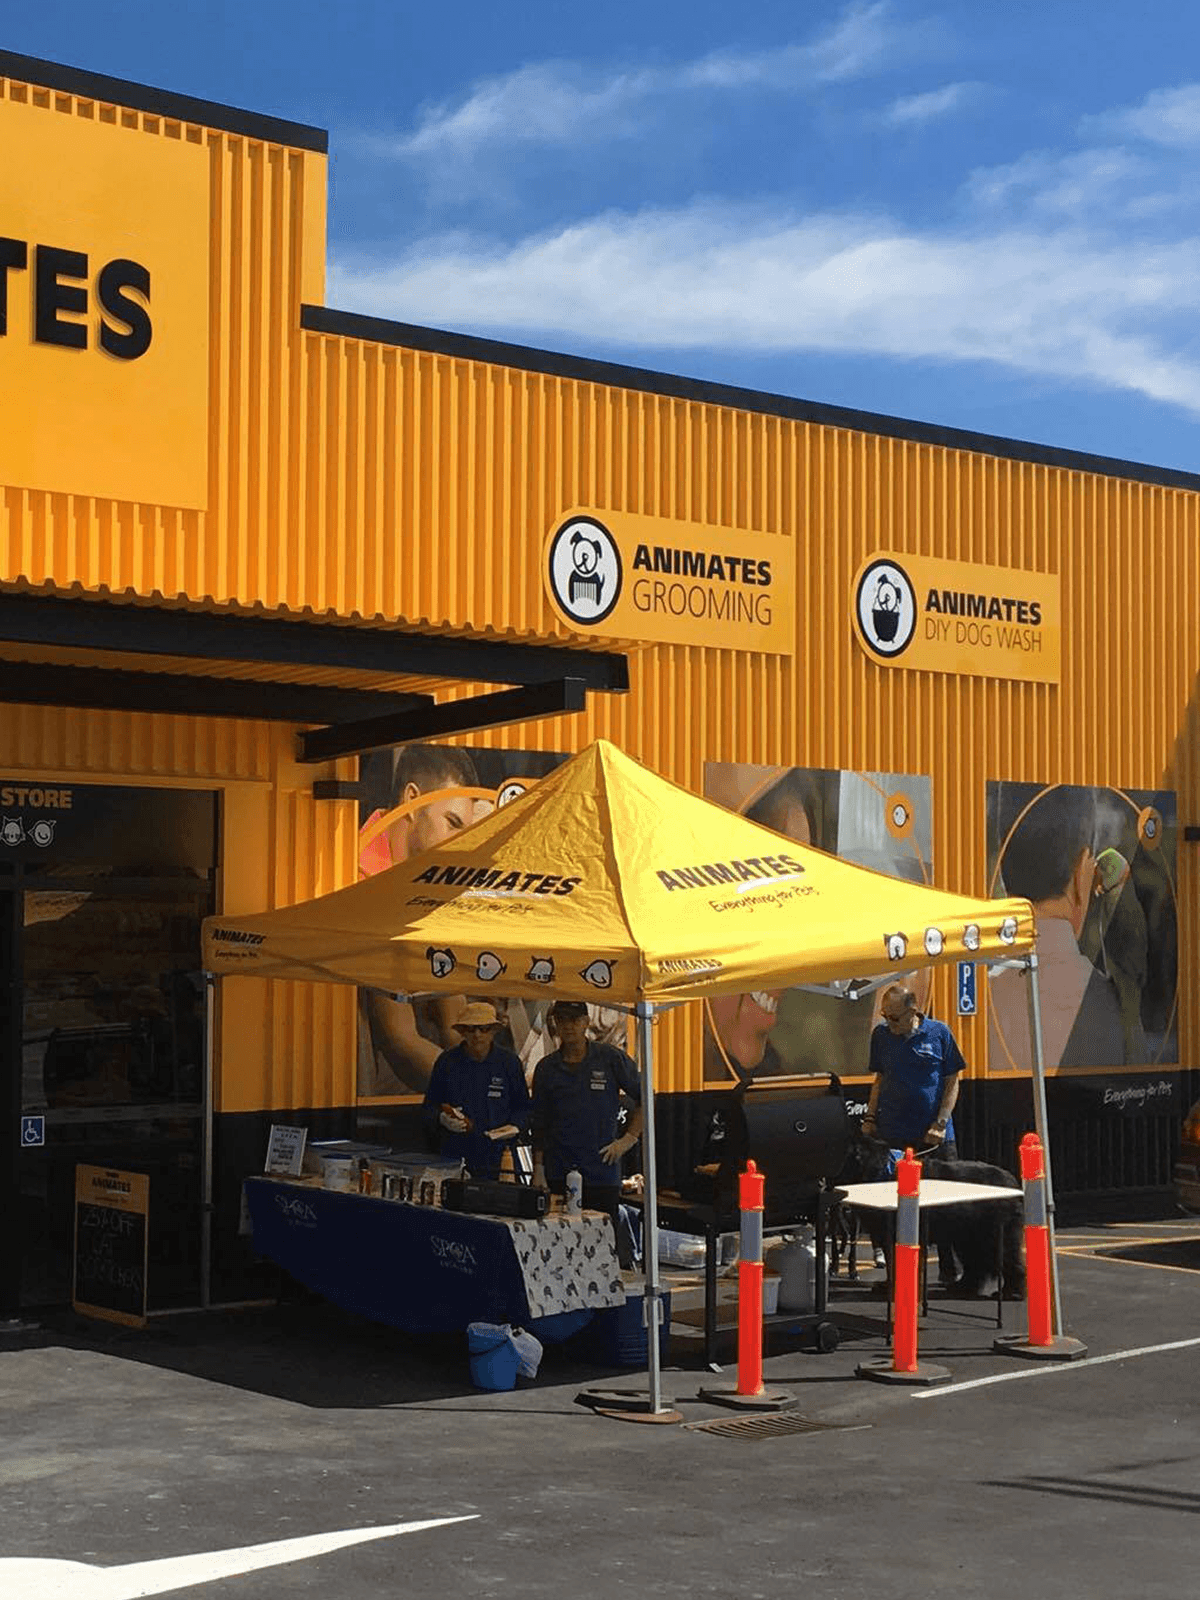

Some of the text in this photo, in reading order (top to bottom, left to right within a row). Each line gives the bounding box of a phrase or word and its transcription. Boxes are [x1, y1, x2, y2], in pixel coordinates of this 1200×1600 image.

[632, 544, 771, 586] ANIMATES
[633, 579, 772, 626] GROOMING
[925, 589, 1041, 625] ANIMATES
[925, 618, 1042, 653] DIY DOG WASH
[1, 787, 73, 808] STORE
[412, 865, 583, 895] ANIMATES
[656, 855, 805, 891] ANIMATES
[708, 894, 783, 913] Everything
[212, 928, 267, 944] ANIMATES
[658, 958, 722, 973] ANIMATES
[963, 964, 971, 985] P
[1104, 1088, 1145, 1110] Everything
[92, 1176, 131, 1193] ANIMATES
